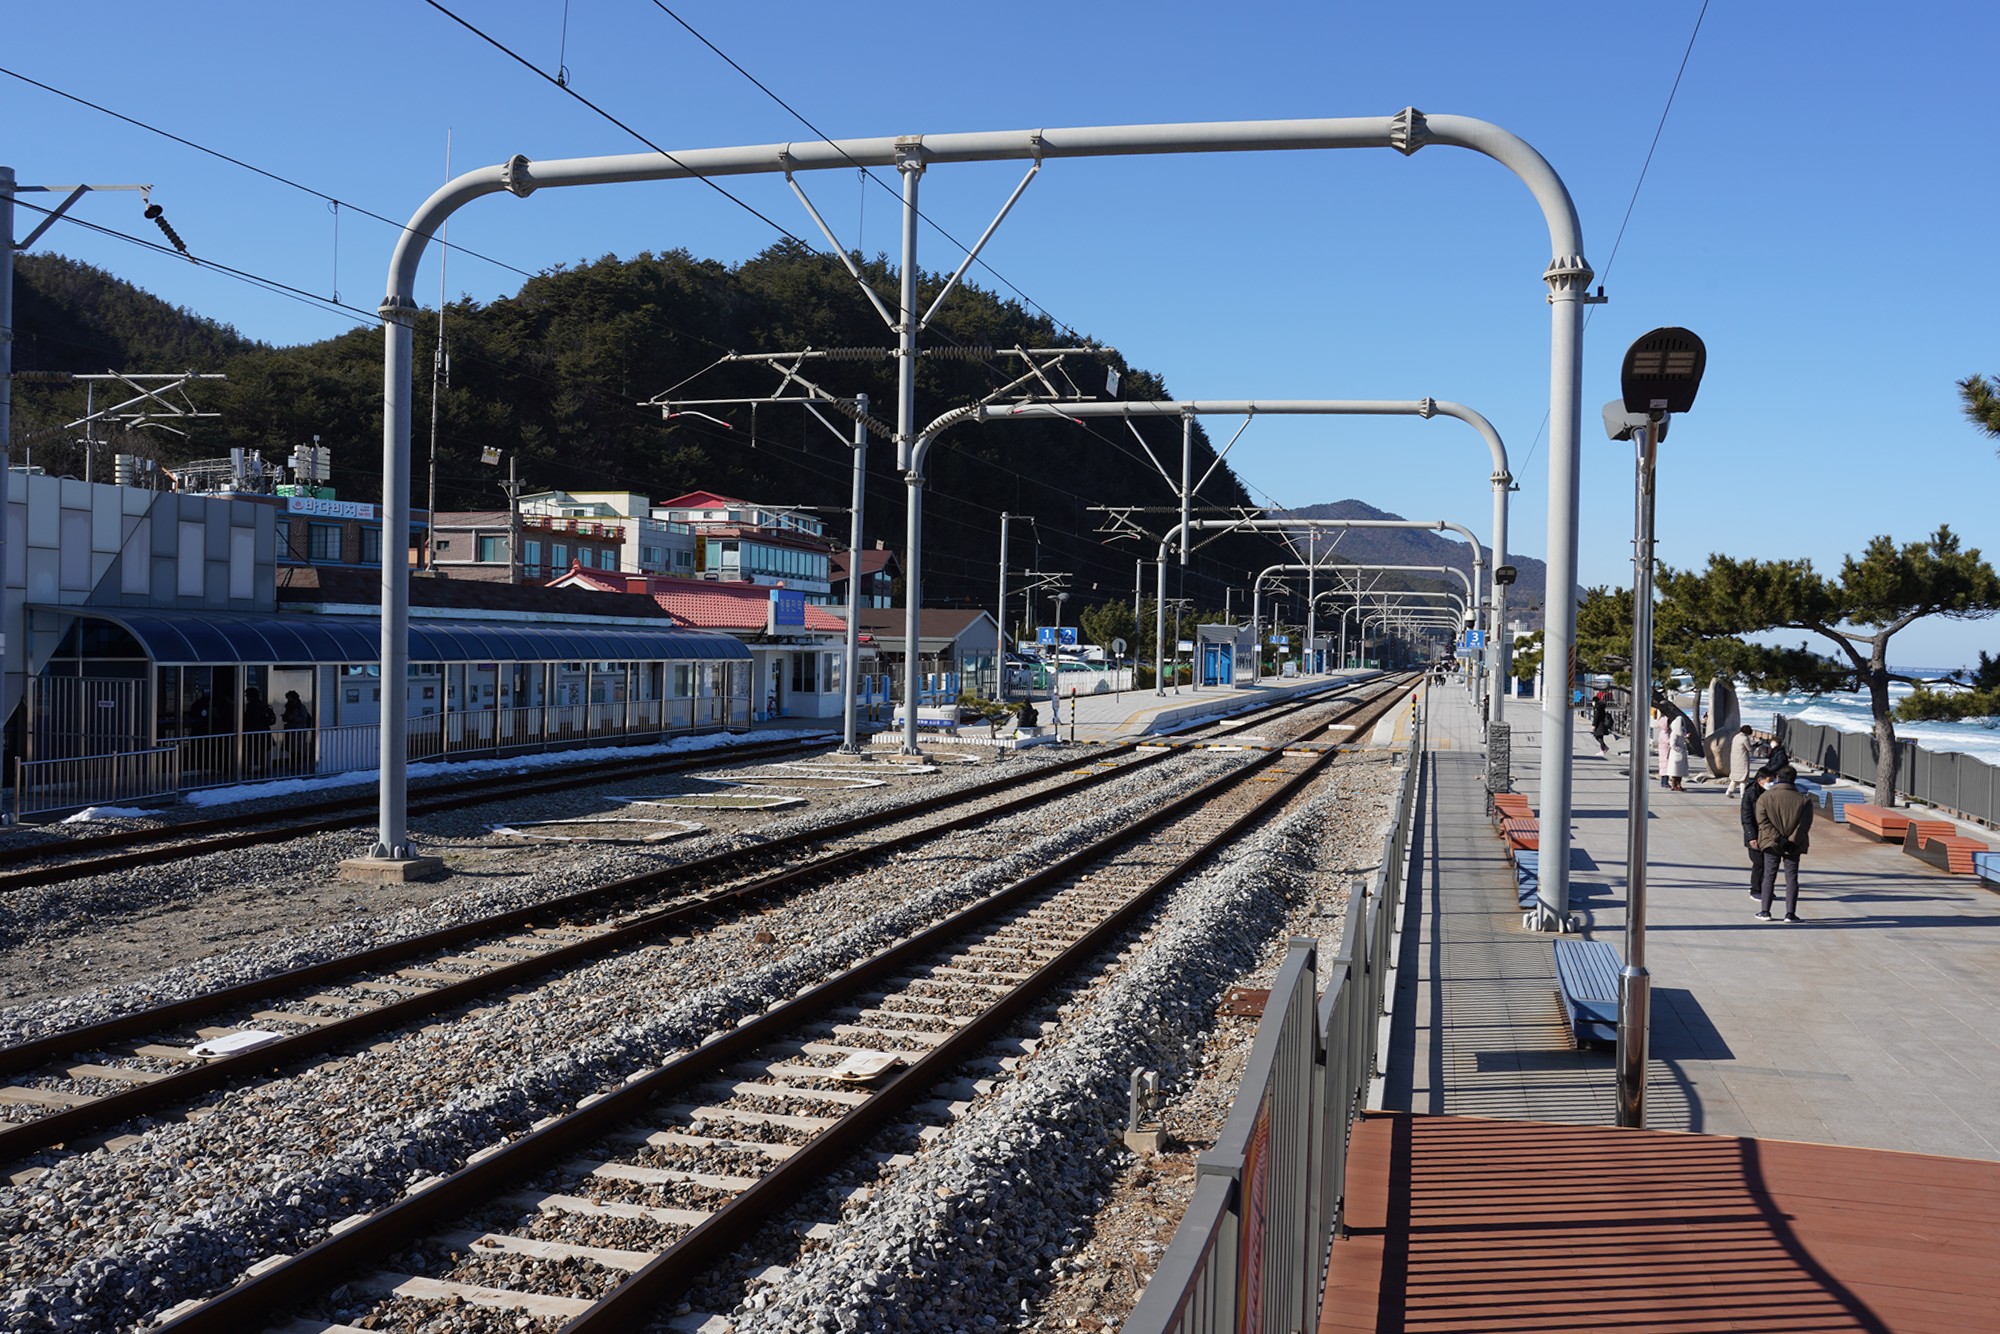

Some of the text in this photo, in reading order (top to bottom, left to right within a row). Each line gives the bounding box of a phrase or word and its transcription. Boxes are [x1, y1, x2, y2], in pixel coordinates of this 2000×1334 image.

[1044, 629, 1050, 638] 1
[1065, 630, 1072, 639] 2
[1471, 632, 1479, 642] 3
